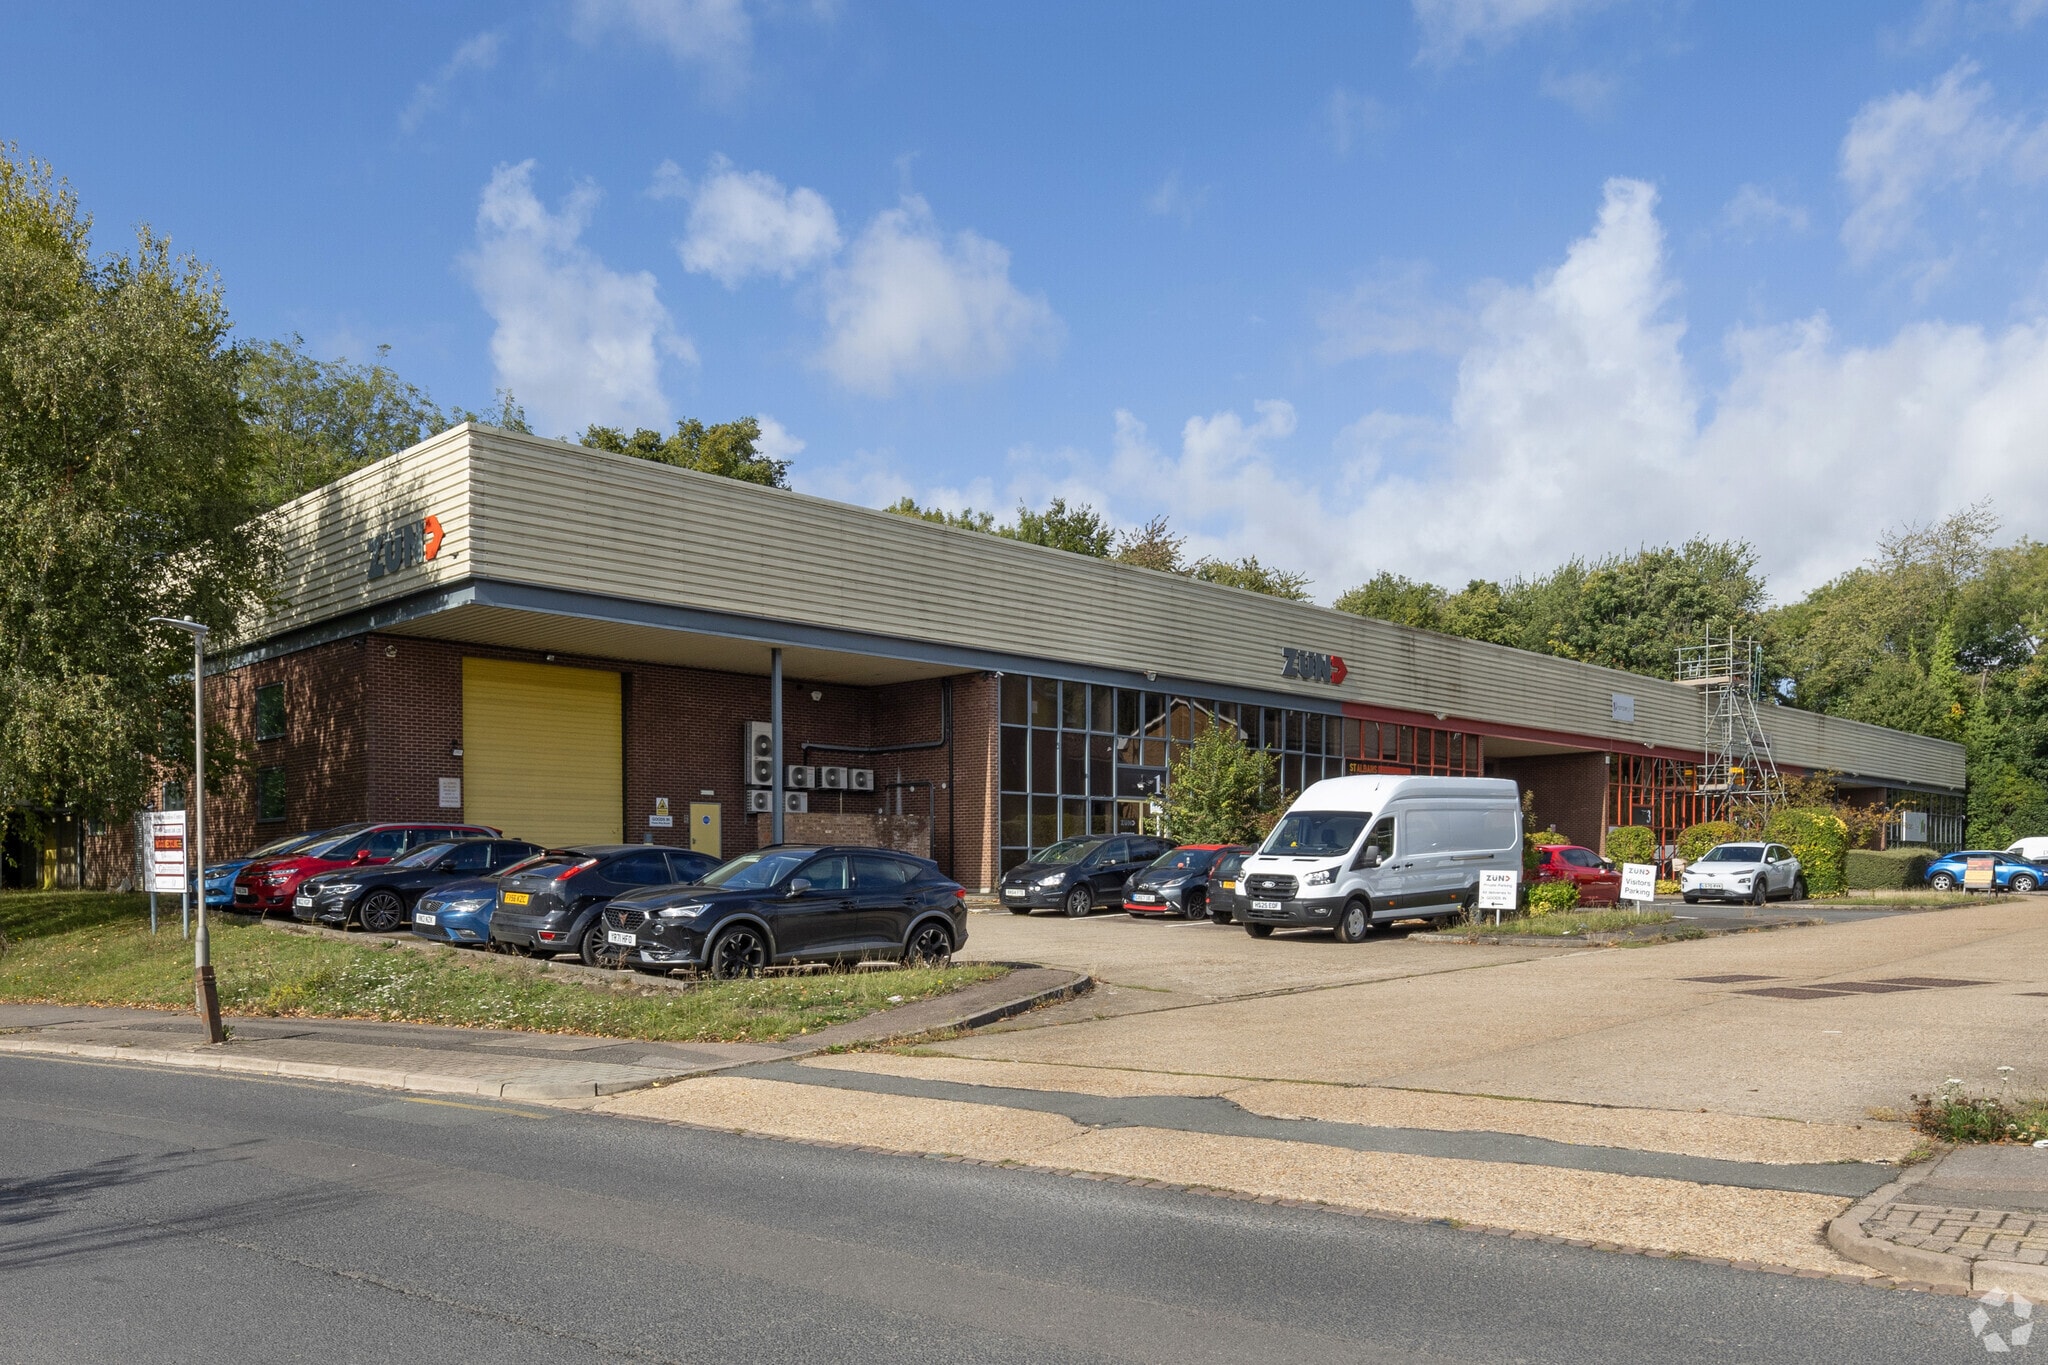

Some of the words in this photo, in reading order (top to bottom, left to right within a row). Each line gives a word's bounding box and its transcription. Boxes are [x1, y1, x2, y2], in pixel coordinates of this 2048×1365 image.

[1154, 774, 1161, 795] 1
[1646, 809, 1651, 823] 3
[1625, 878, 1651, 887] Visitors
[1624, 886, 1651, 897] Parking
